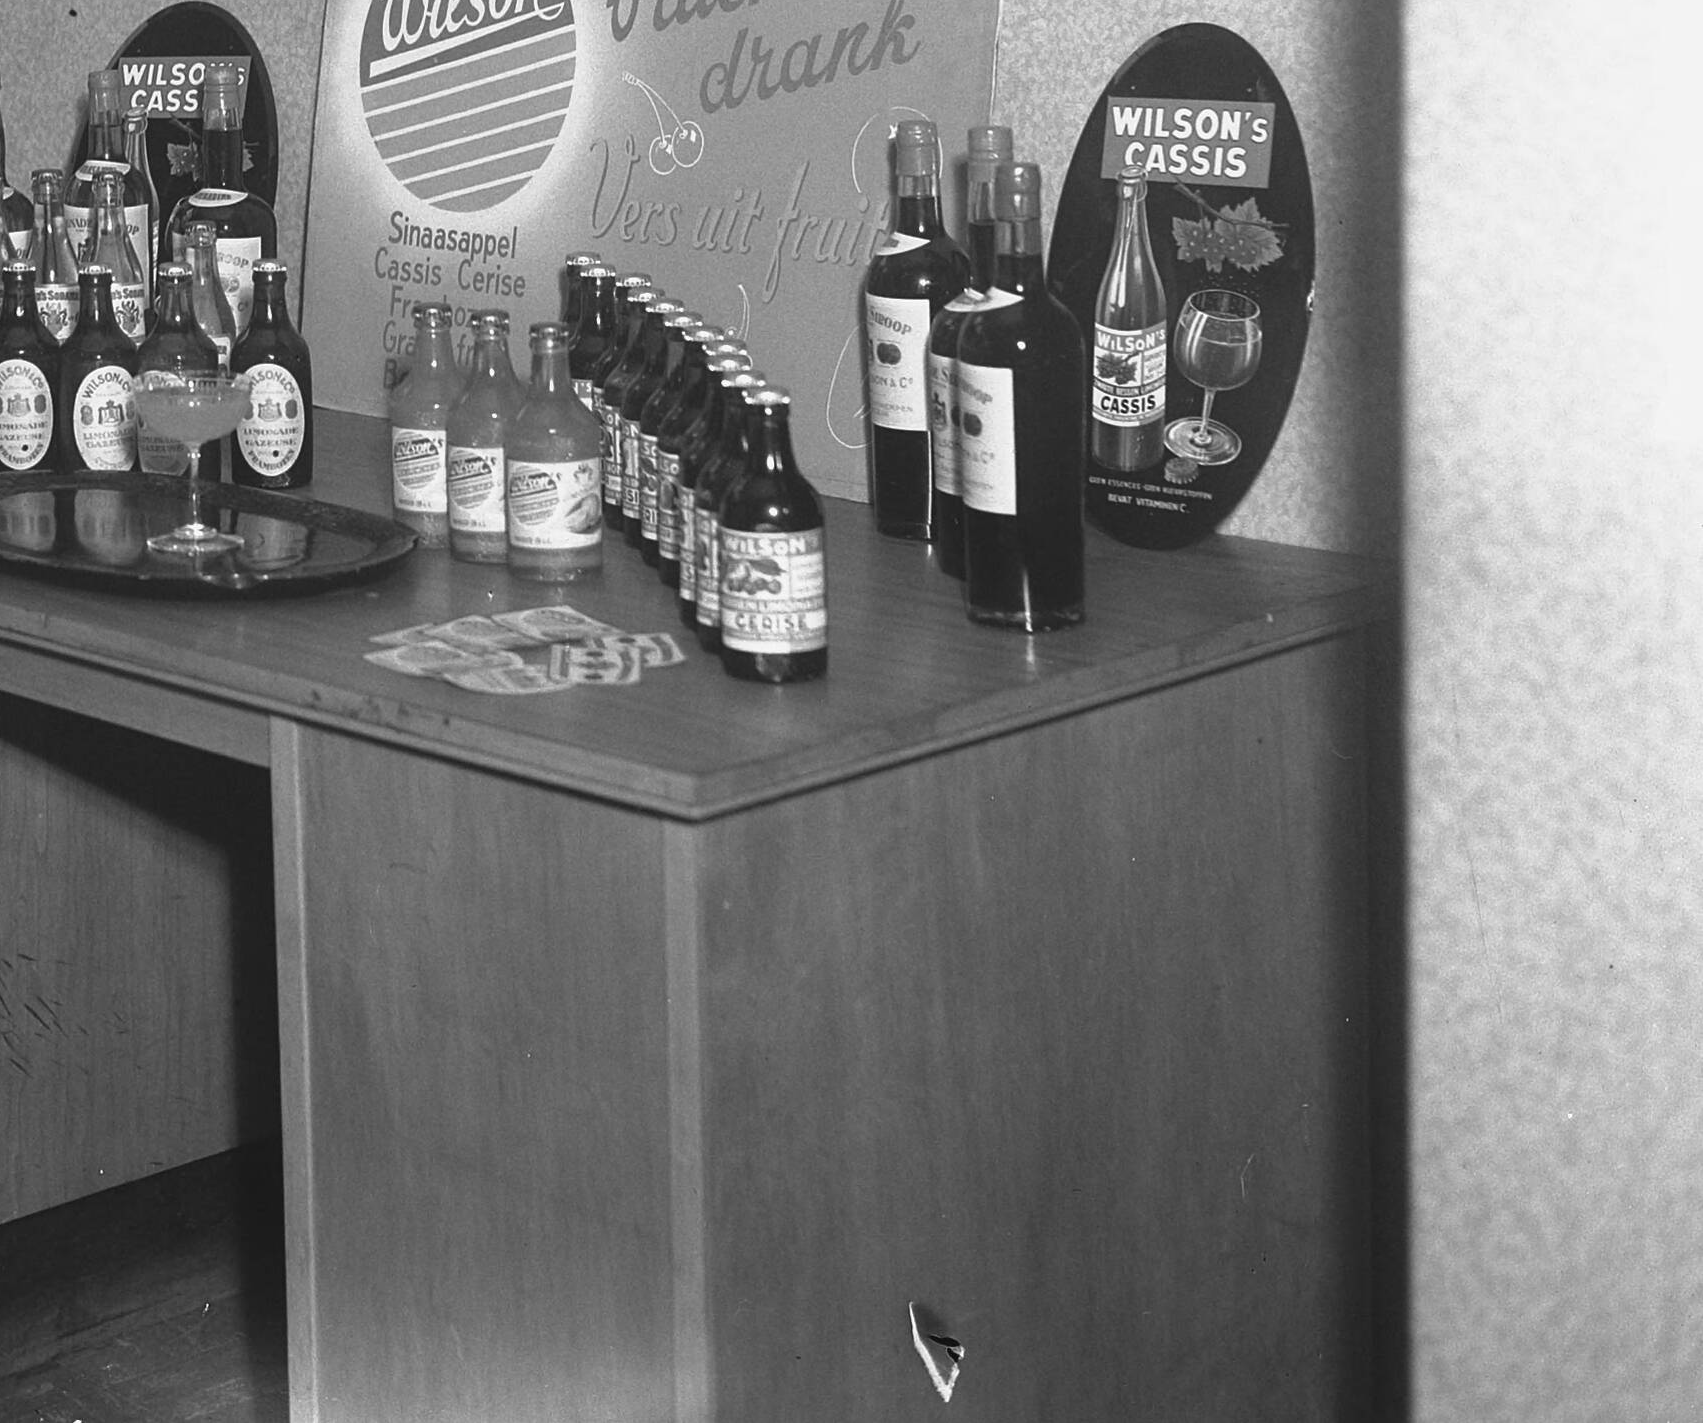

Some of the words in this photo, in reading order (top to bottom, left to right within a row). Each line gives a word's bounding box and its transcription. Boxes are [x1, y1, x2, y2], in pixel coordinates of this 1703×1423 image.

[130, 89, 199, 112] CASS
[1112, 106, 1269, 143] WILSON's
[1124, 141, 1247, 178] CASSIS
[388, 210, 518, 264] Sinaasappel
[590, 133, 682, 246] Vers
[693, 187, 765, 254] uit
[762, 159, 892, 304] fruit
[374, 246, 442, 286] Cassis
[457, 258, 526, 298] Cerise
[1100, 394, 1156, 414] CASSIS
